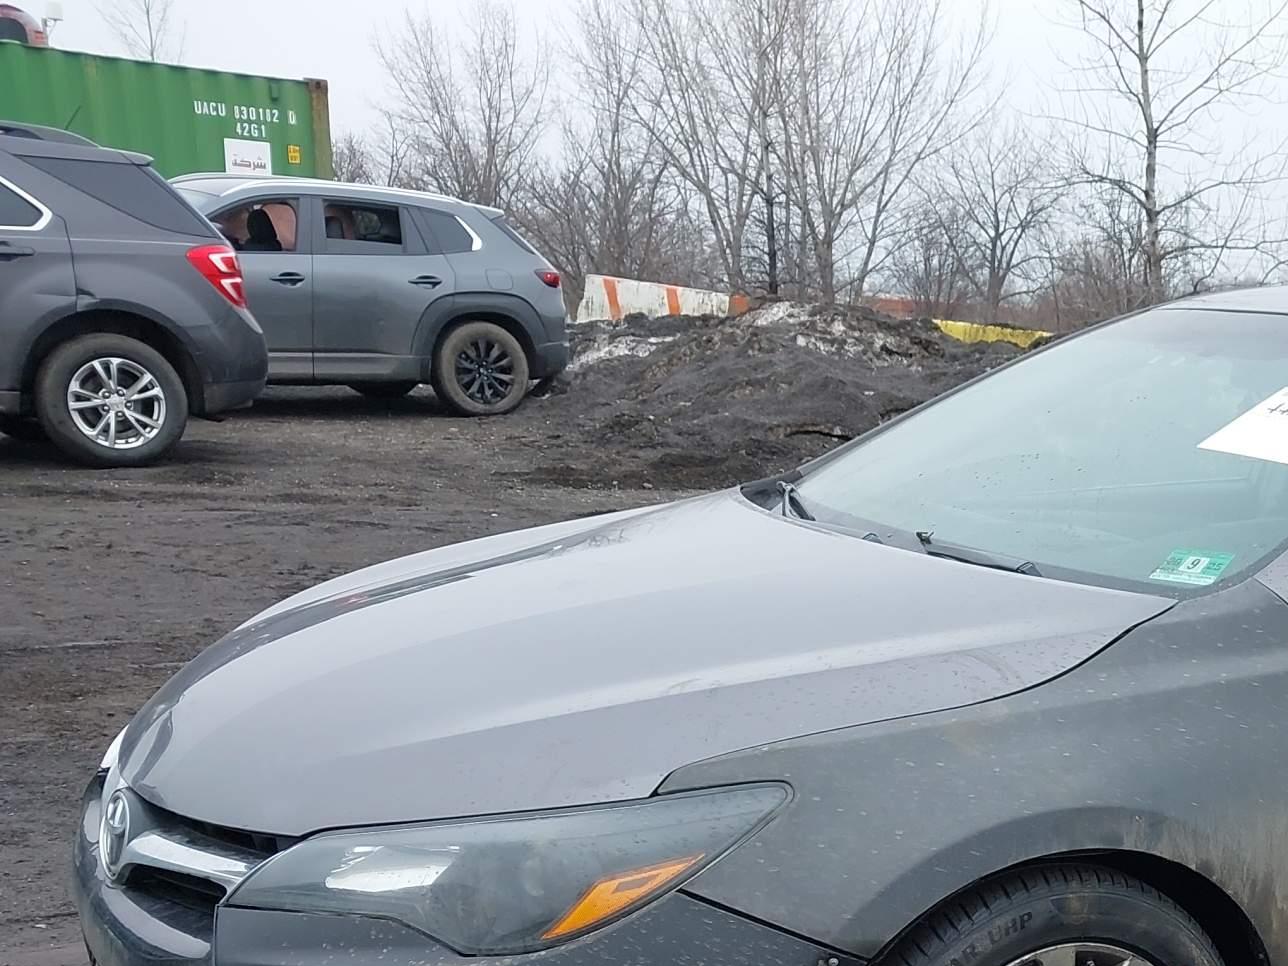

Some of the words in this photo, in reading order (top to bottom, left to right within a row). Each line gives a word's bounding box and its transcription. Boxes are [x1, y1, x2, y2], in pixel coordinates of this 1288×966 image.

[193, 100, 226, 117] UACU
[236, 122, 266, 138] 42G1
[1186, 558, 1202, 570] 9
[988, 911, 1033, 944] UHP
